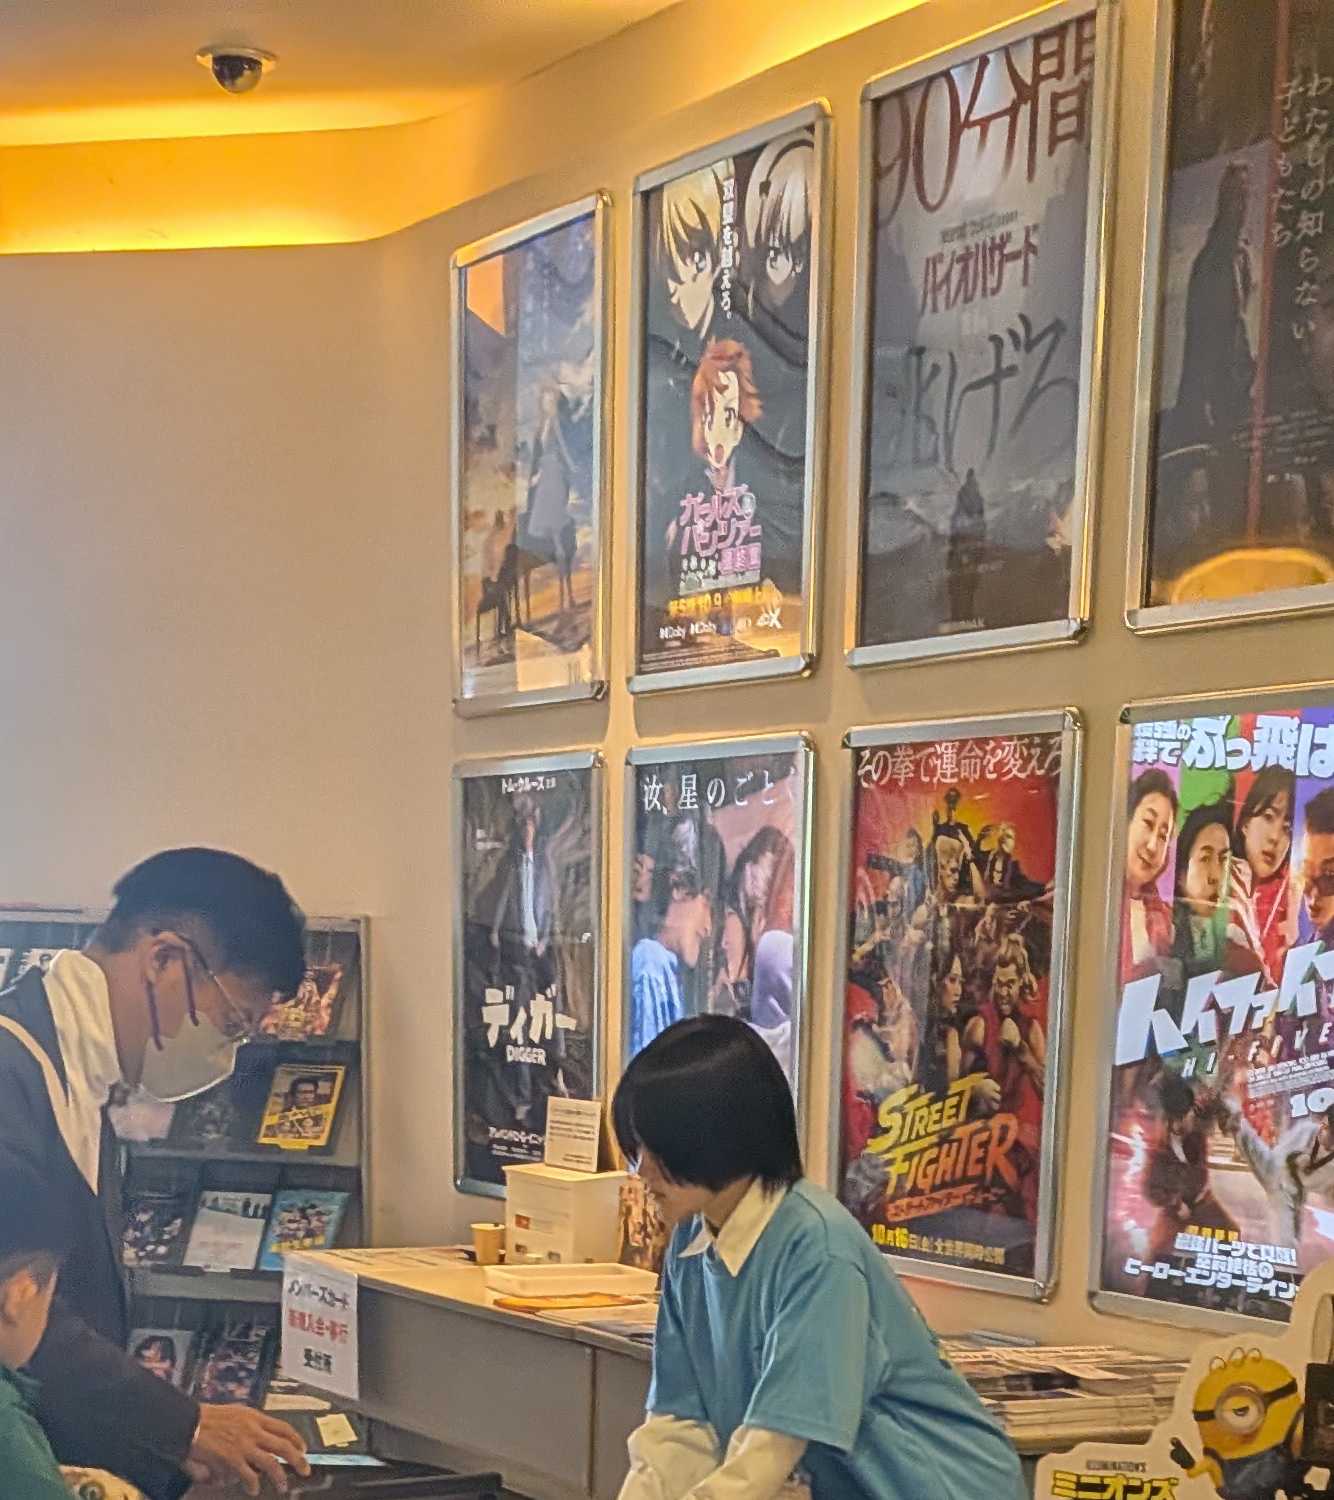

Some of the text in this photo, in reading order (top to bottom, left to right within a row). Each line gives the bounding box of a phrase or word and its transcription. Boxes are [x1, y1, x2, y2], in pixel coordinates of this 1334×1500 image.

[921, 223, 1040, 316] バイオハザード
[481, 983, 578, 1049] ディガー
[505, 1044, 547, 1067] DIGGER
[867, 1071, 991, 1153] STREET
[879, 1112, 1019, 1196] FIGHTER
[1124, 1257, 1299, 1299] ヒーローエンターテイン
